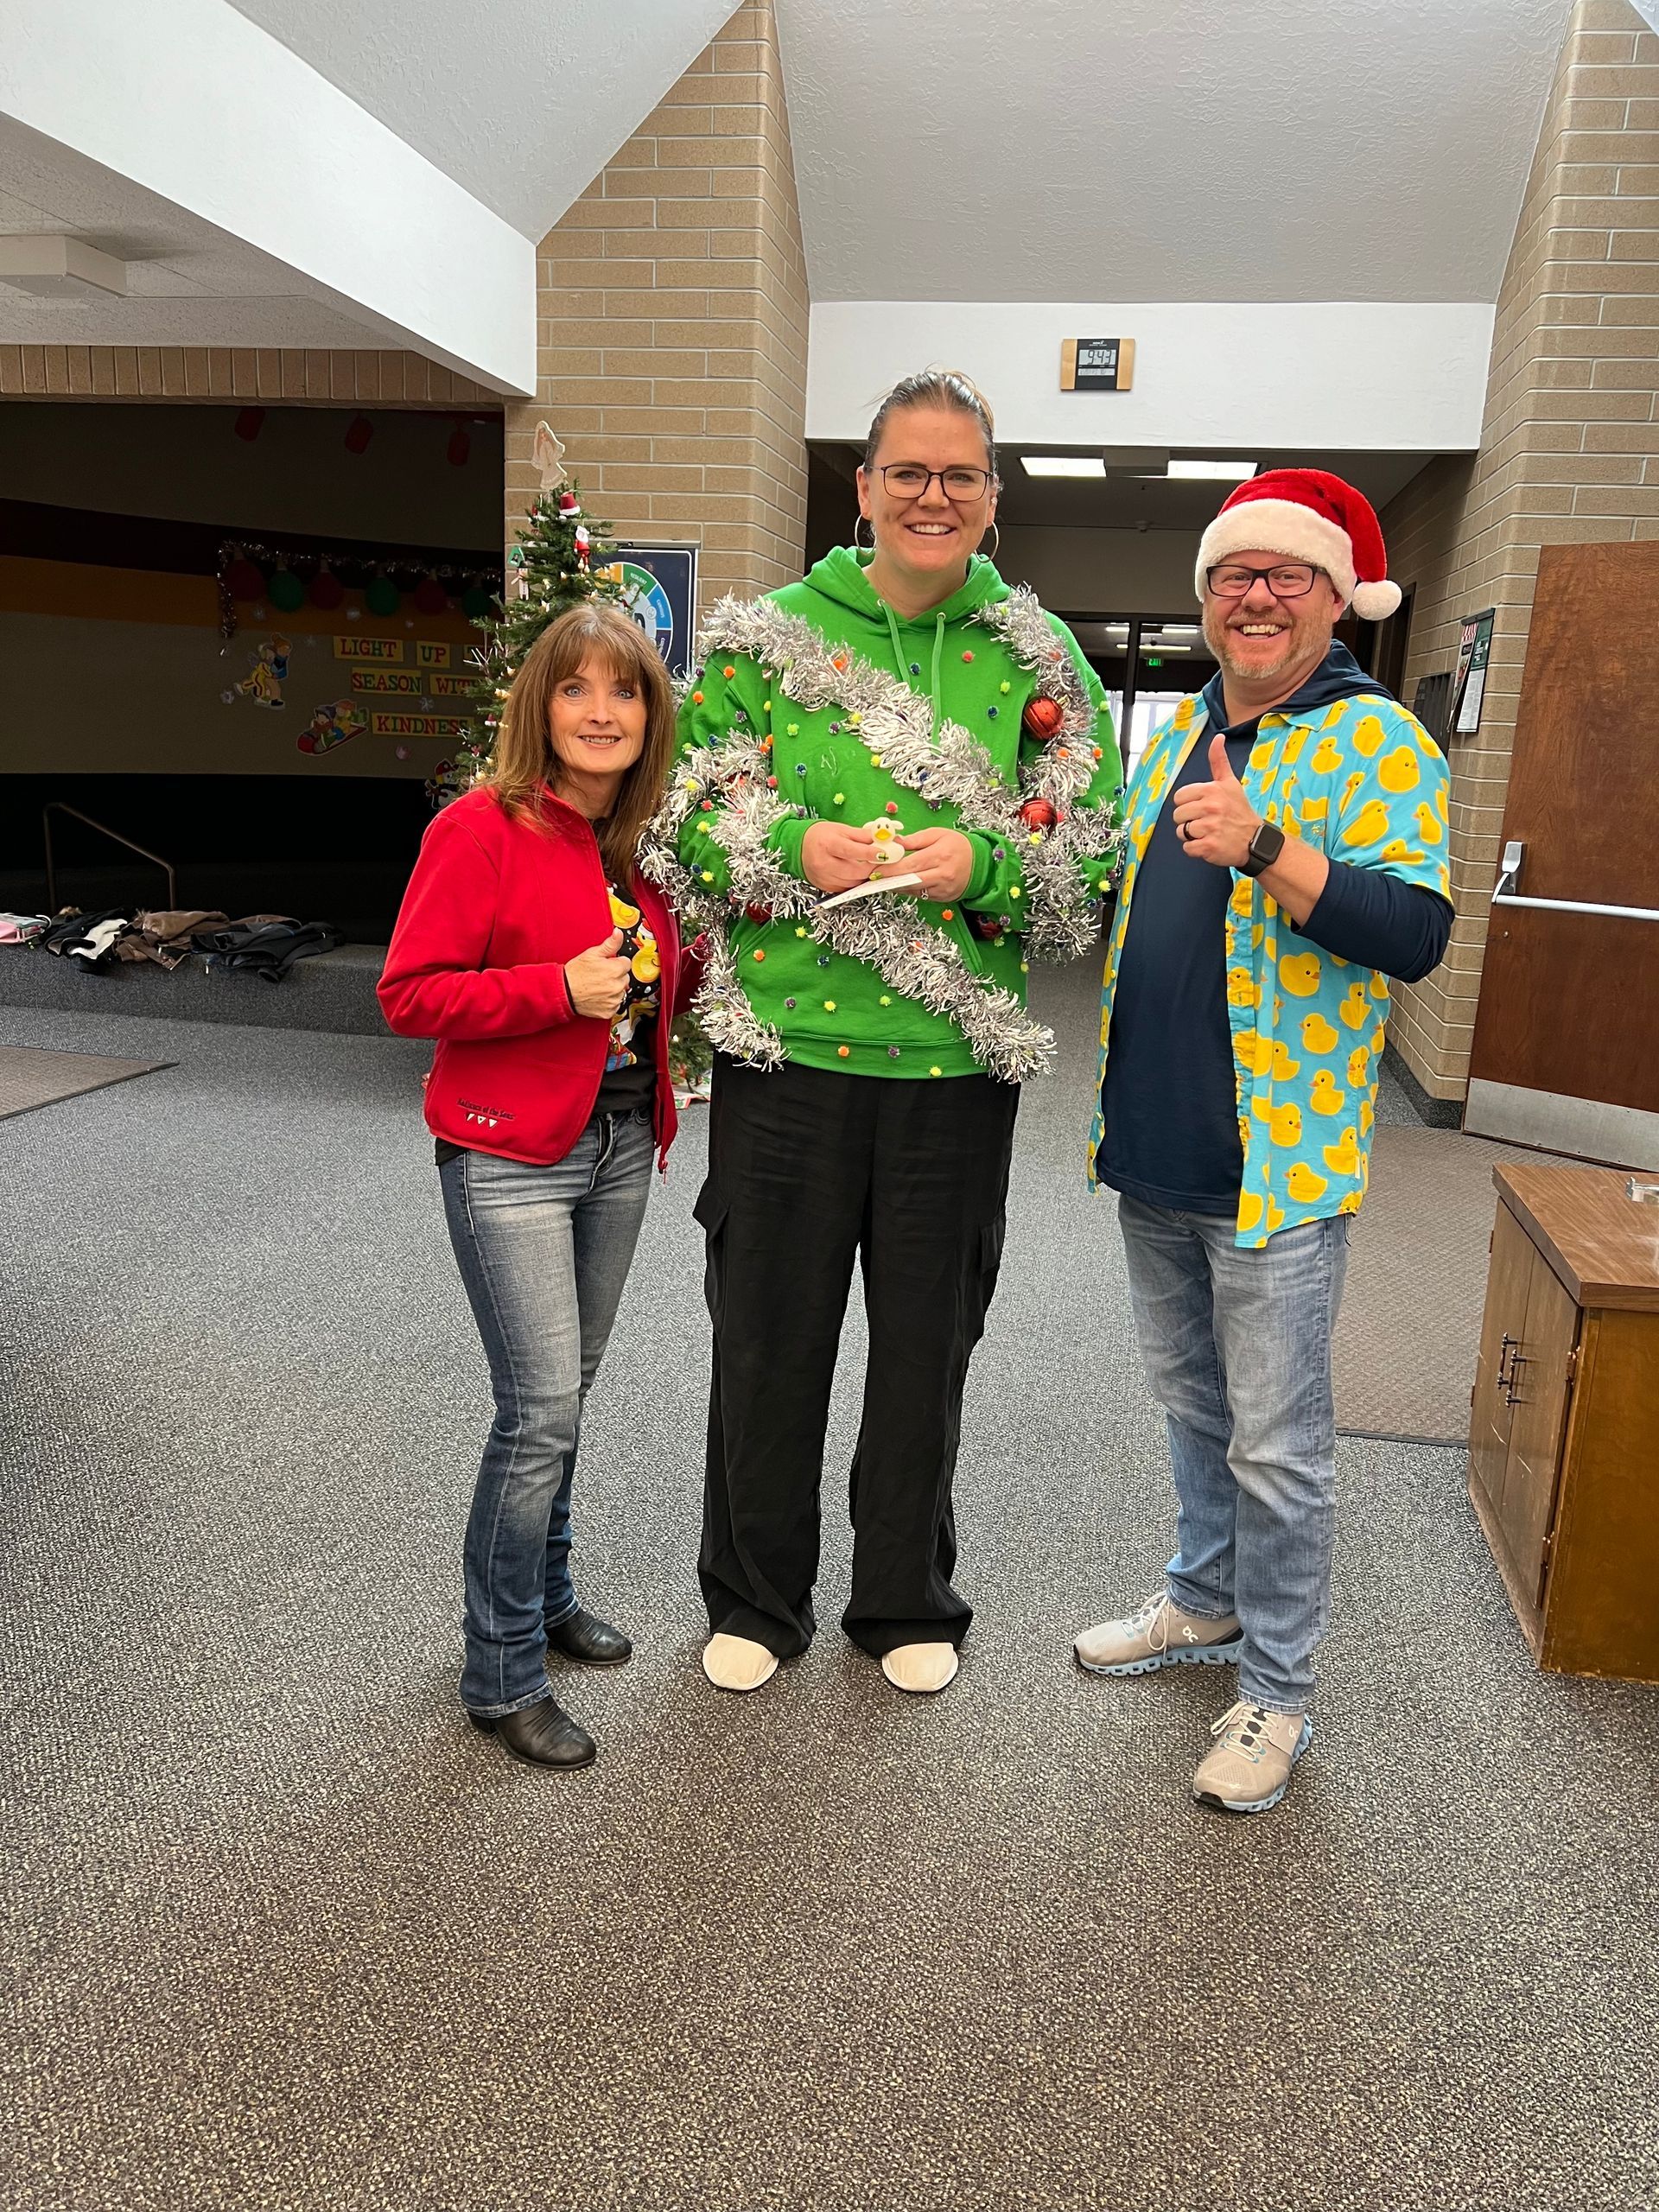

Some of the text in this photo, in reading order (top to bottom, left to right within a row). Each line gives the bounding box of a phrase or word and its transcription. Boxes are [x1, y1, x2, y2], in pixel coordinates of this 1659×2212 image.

[340, 638, 397, 658] LIGHT
[421, 645, 447, 663] UP
[352, 672, 422, 692] SEASON
